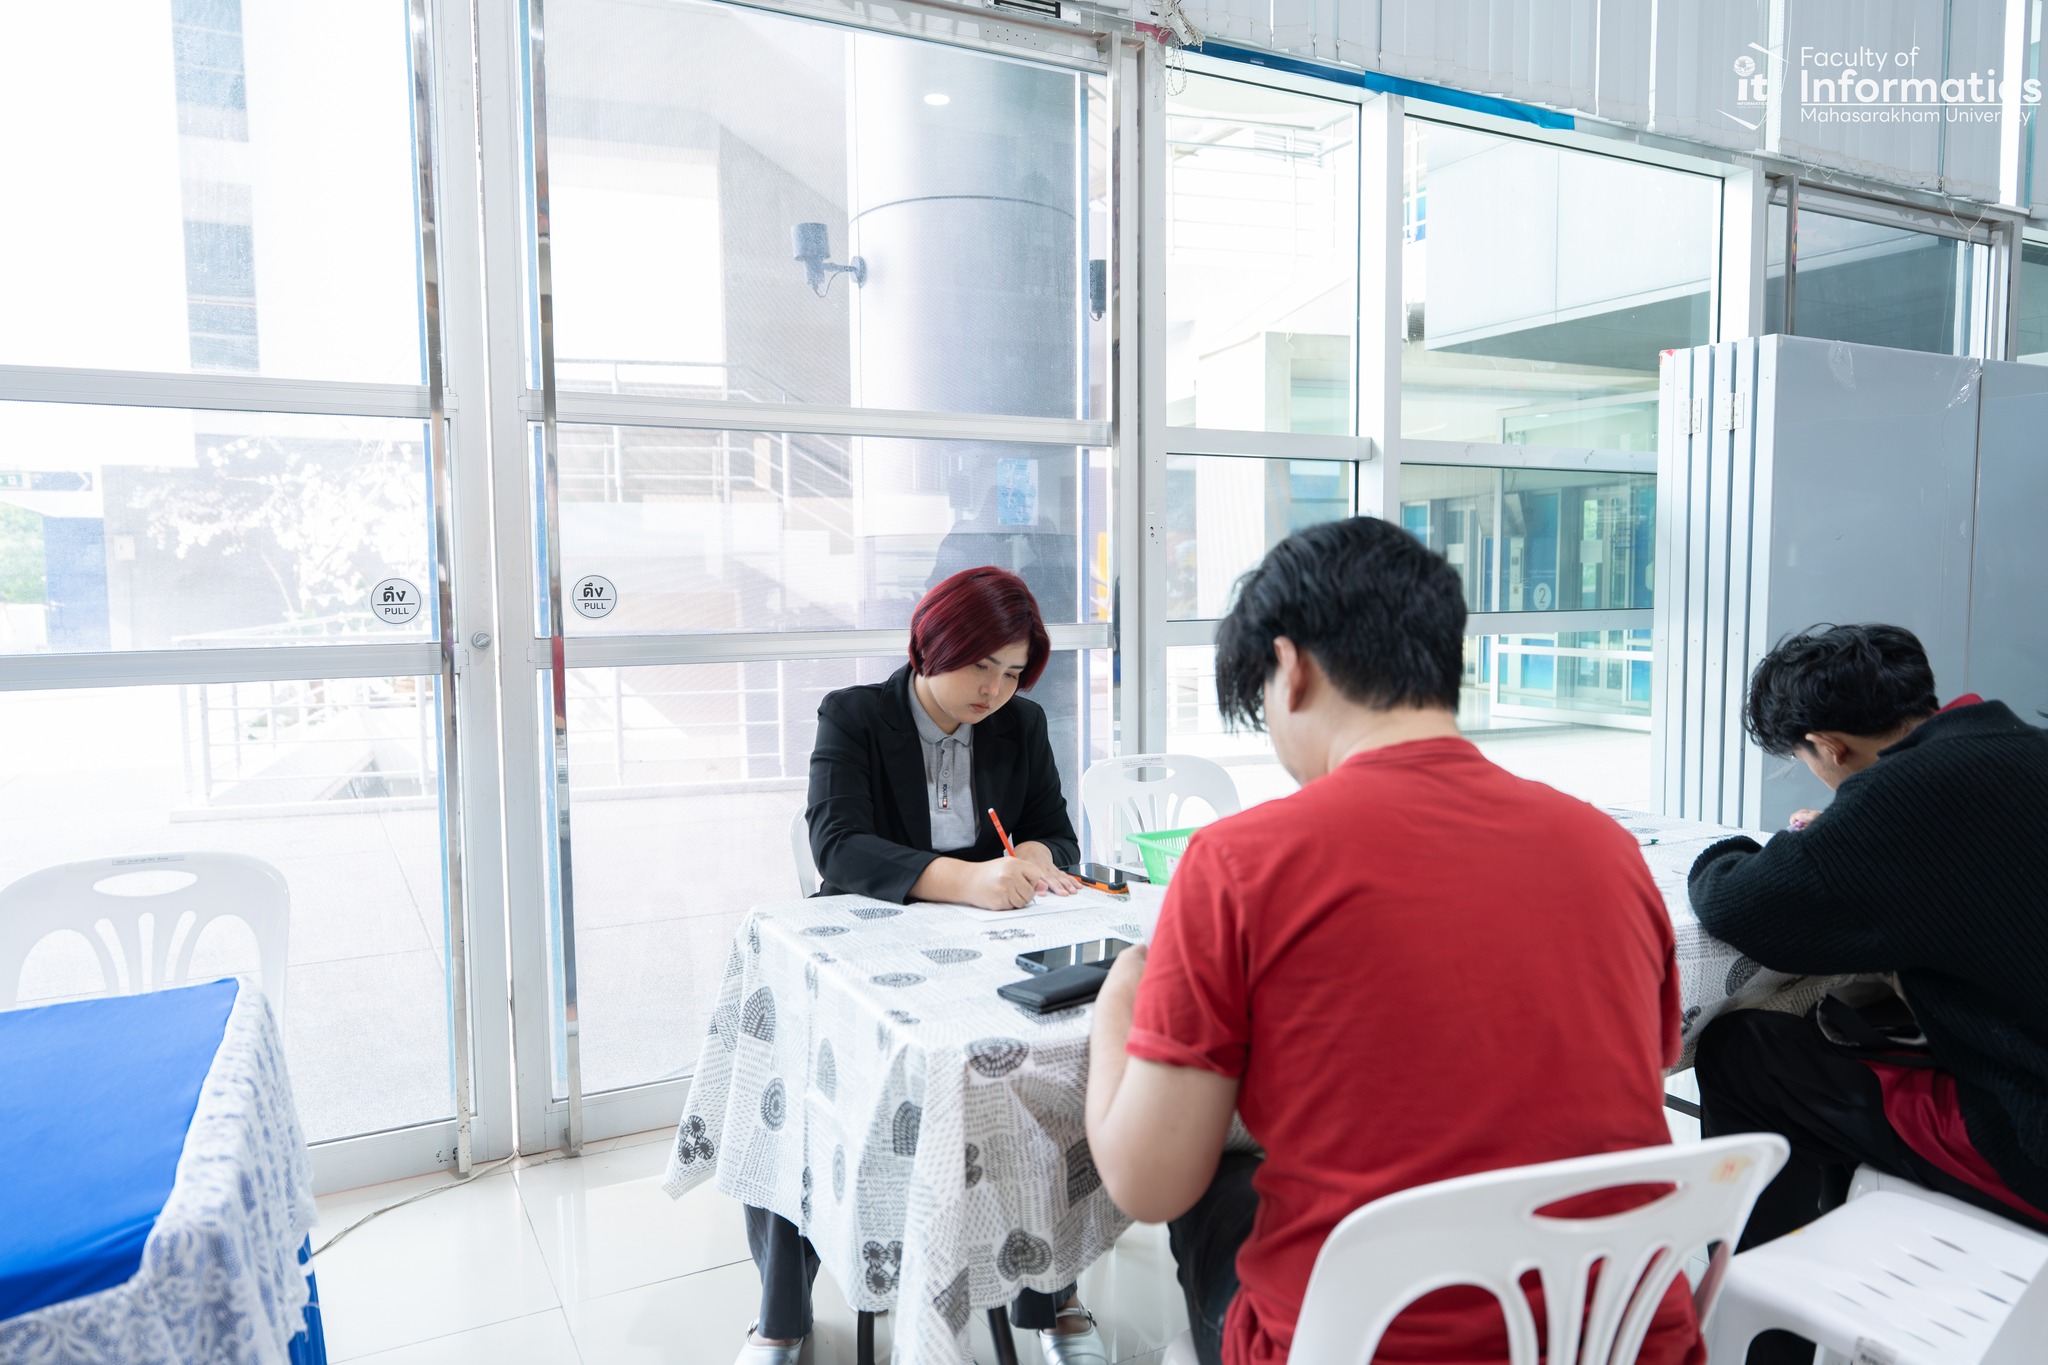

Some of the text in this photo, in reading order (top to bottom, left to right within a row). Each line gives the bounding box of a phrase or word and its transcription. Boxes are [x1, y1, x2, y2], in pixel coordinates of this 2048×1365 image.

[383, 585, 407, 602] ดึง
[583, 582, 605, 598] ดึง
[1538, 587, 1547, 604] 2
[384, 607, 410, 615] PULL
[584, 602, 607, 610] PULL
